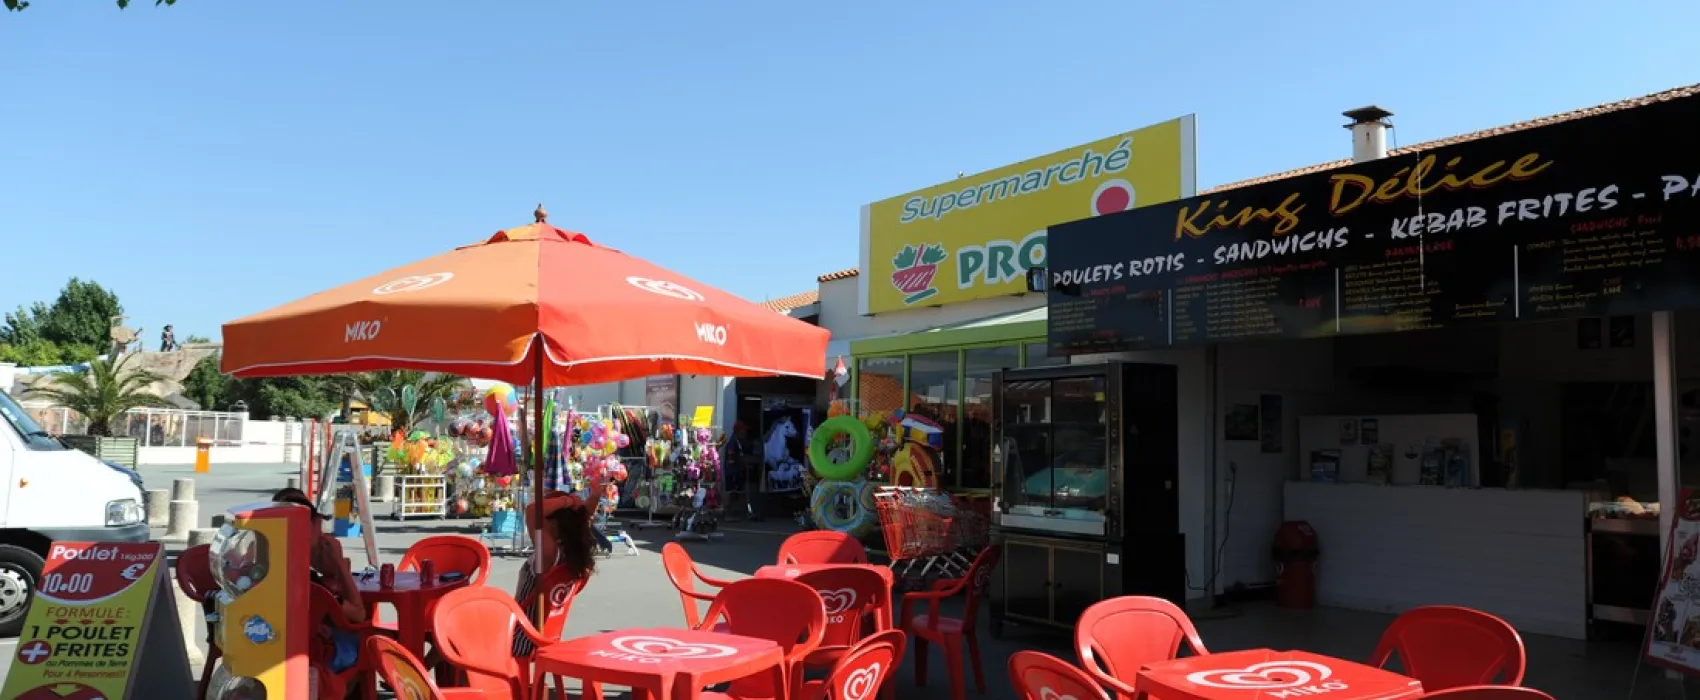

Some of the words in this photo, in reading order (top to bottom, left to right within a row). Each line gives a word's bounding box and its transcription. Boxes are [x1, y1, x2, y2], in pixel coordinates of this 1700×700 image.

[901, 138, 1132, 222] Supermarché
[1175, 192, 1306, 241] King
[1329, 152, 1554, 216] Délice
[1053, 262, 1123, 286] POULETS
[1129, 252, 1185, 277] ROTIS
[1214, 227, 1349, 266] SANDWICHS
[1391, 206, 1487, 240] KEBAB
[1498, 184, 1618, 226] FRITES
[344, 320, 381, 343] MIKO
[693, 321, 727, 346] MIKO
[52, 545, 118, 560] Poulet
[32, 626, 40, 639] 1
[46, 627, 134, 640] POULET
[53, 643, 130, 657] FRITES
[588, 650, 661, 663] MIKO
[1265, 683, 1349, 699] MIKO
